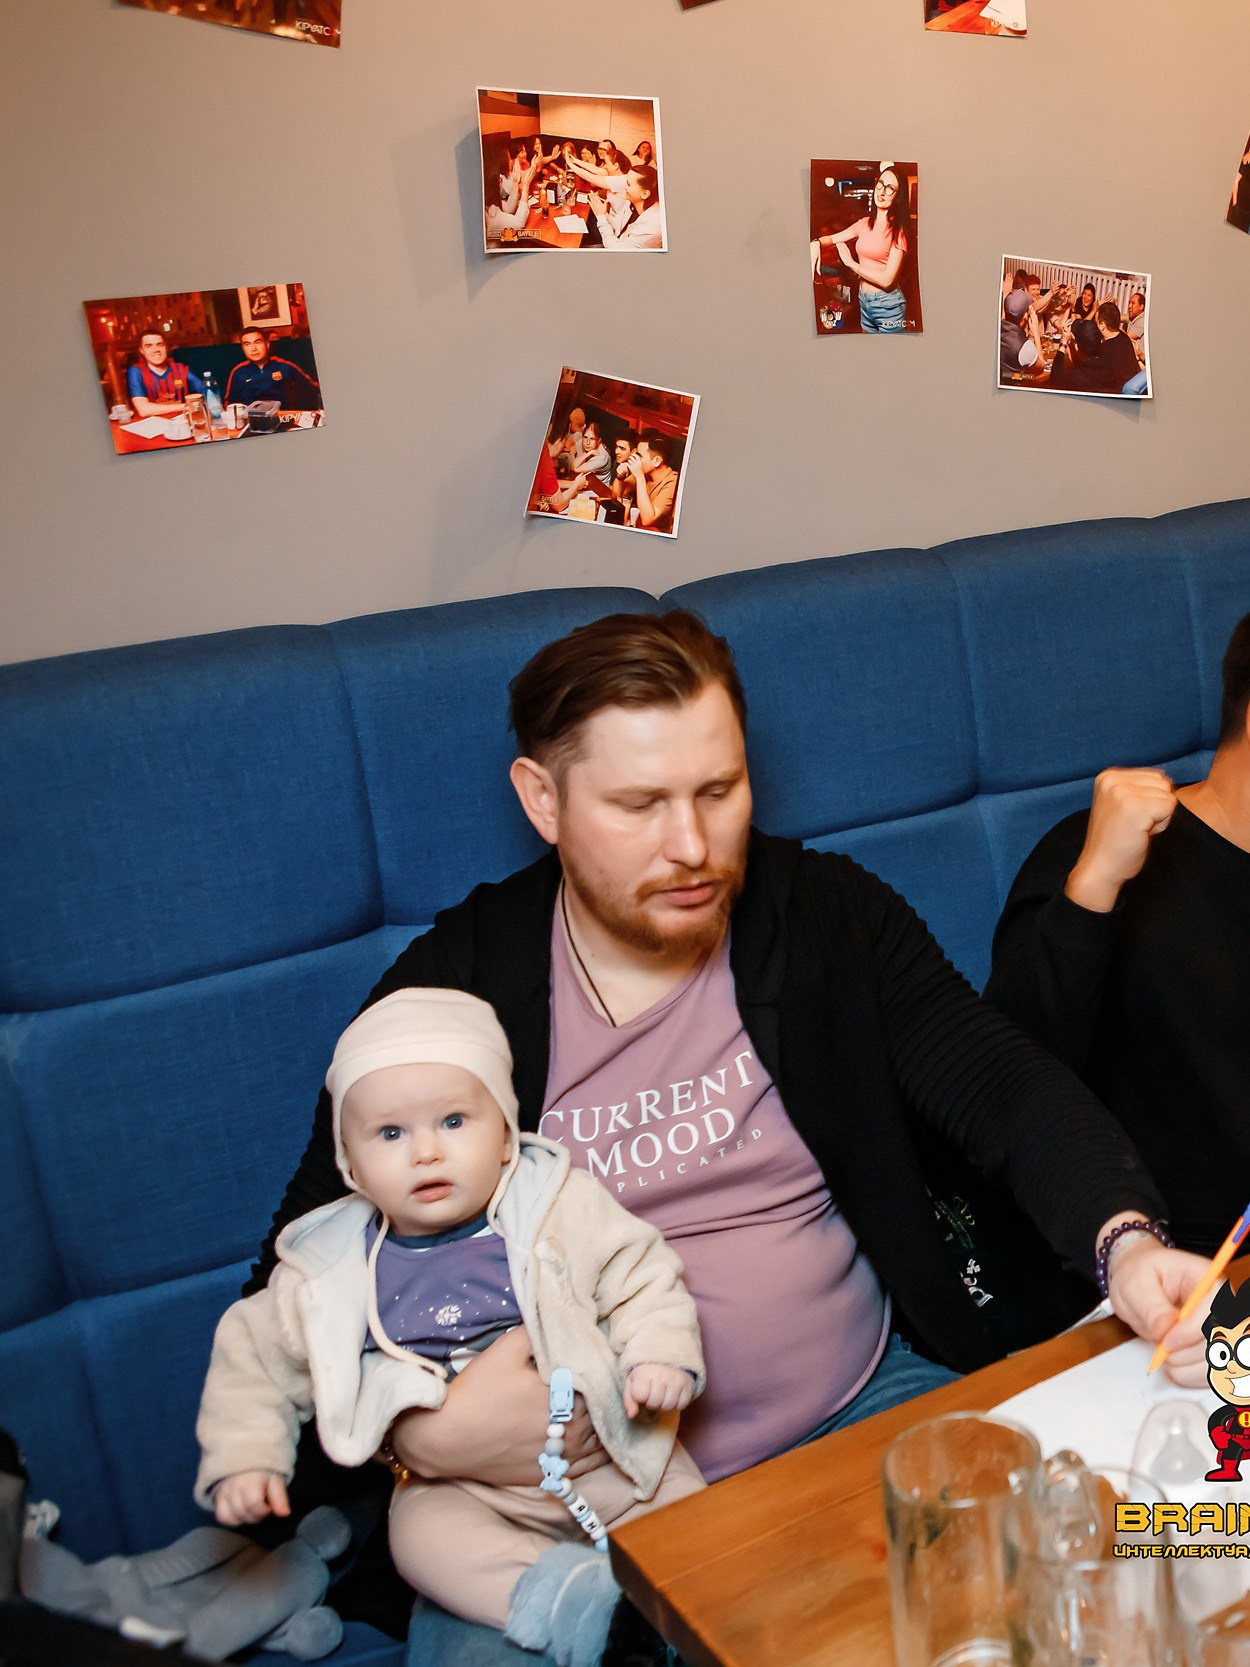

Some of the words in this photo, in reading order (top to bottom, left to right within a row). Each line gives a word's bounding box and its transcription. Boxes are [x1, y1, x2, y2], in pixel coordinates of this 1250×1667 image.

[537, 1051, 753, 1144] CURRENT
[586, 1108, 736, 1180] MOOD
[616, 1128, 763, 1193] PLICATED
